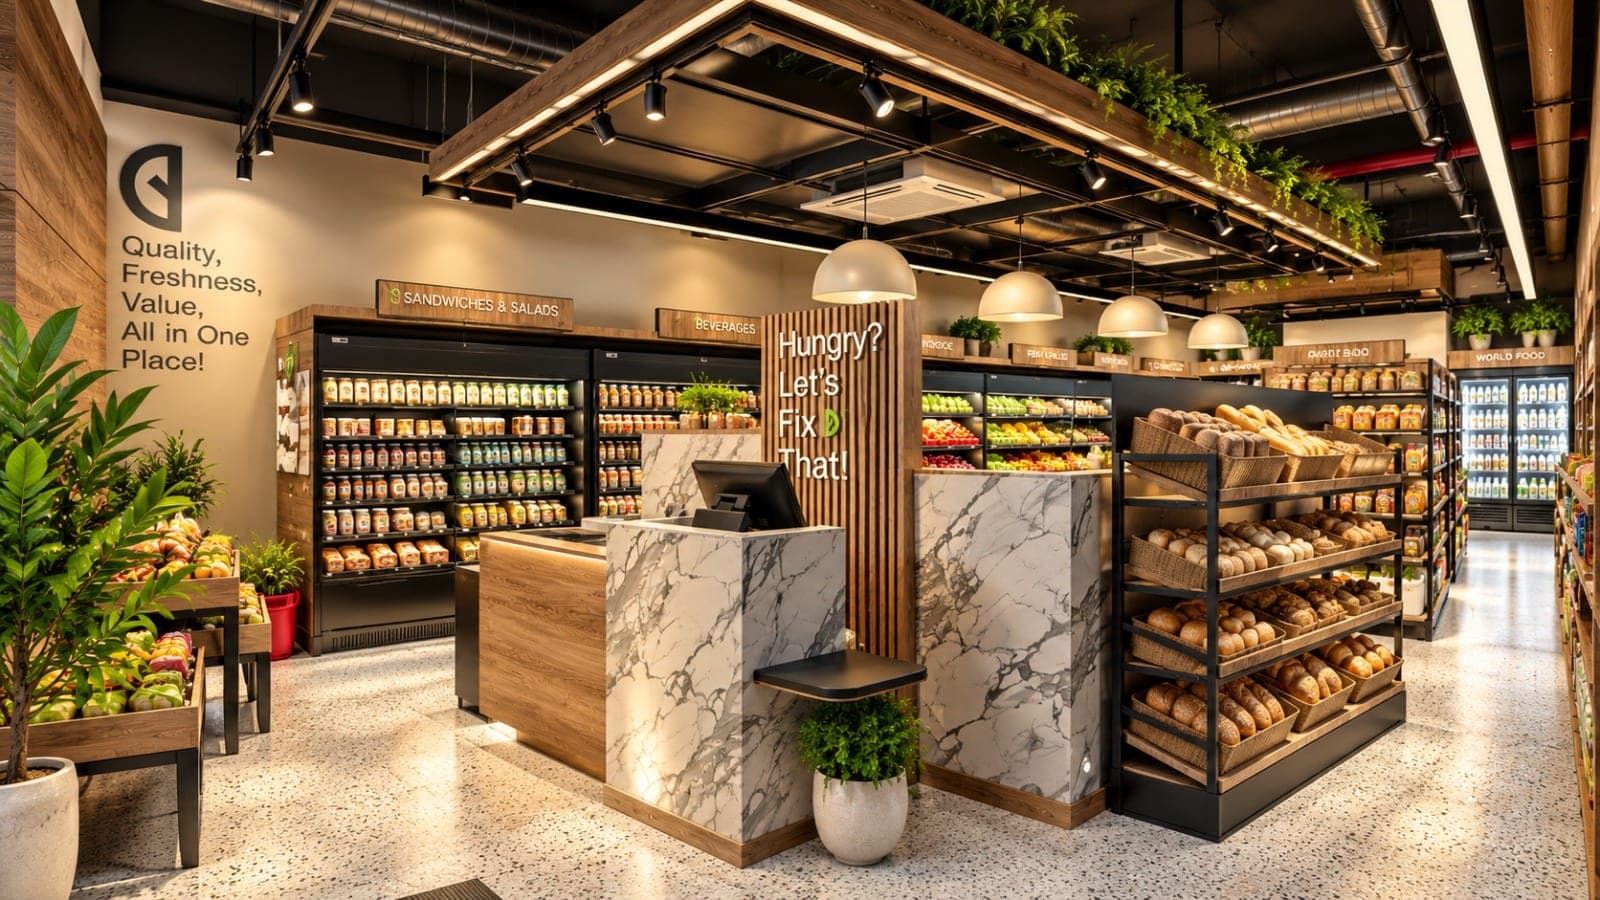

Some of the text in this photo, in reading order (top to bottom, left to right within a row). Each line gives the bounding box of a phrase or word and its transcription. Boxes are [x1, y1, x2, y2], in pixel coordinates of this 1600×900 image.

[121, 235, 221, 267] Quality,
[122, 263, 262, 297] Freshness,
[121, 291, 203, 319] Value,
[403, 291, 560, 317] SANDWICHES & SALADS
[121, 321, 249, 346] All in One
[695, 318, 756, 335] BEVERAGES
[778, 321, 882, 361] Hungry?
[121, 349, 204, 371] Place!
[1476, 351, 1546, 362] WORLD FOOD
[779, 367, 840, 397] Let's
[779, 408, 817, 438] Fix
[778, 448, 848, 481] That!
